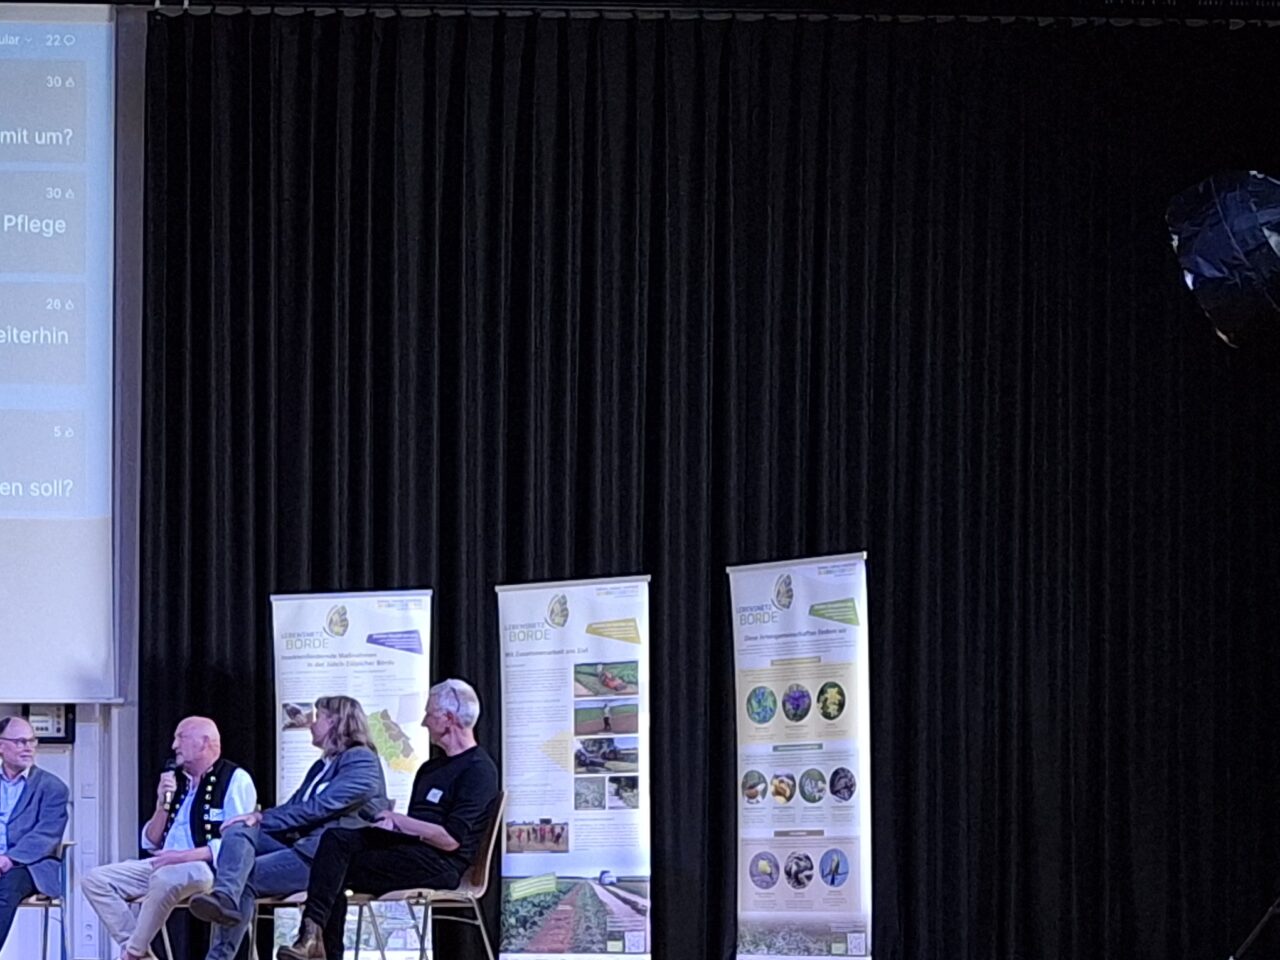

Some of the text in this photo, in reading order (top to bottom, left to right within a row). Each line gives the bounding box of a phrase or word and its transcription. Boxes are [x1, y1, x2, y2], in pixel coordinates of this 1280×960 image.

[45, 34, 61, 47] 22
[46, 75, 62, 88] 30
[35, 128, 73, 145] um?
[45, 187, 62, 199] 30
[4, 214, 66, 237] Pflege
[53, 425, 62, 438] 5
[30, 479, 73, 497] soll?
